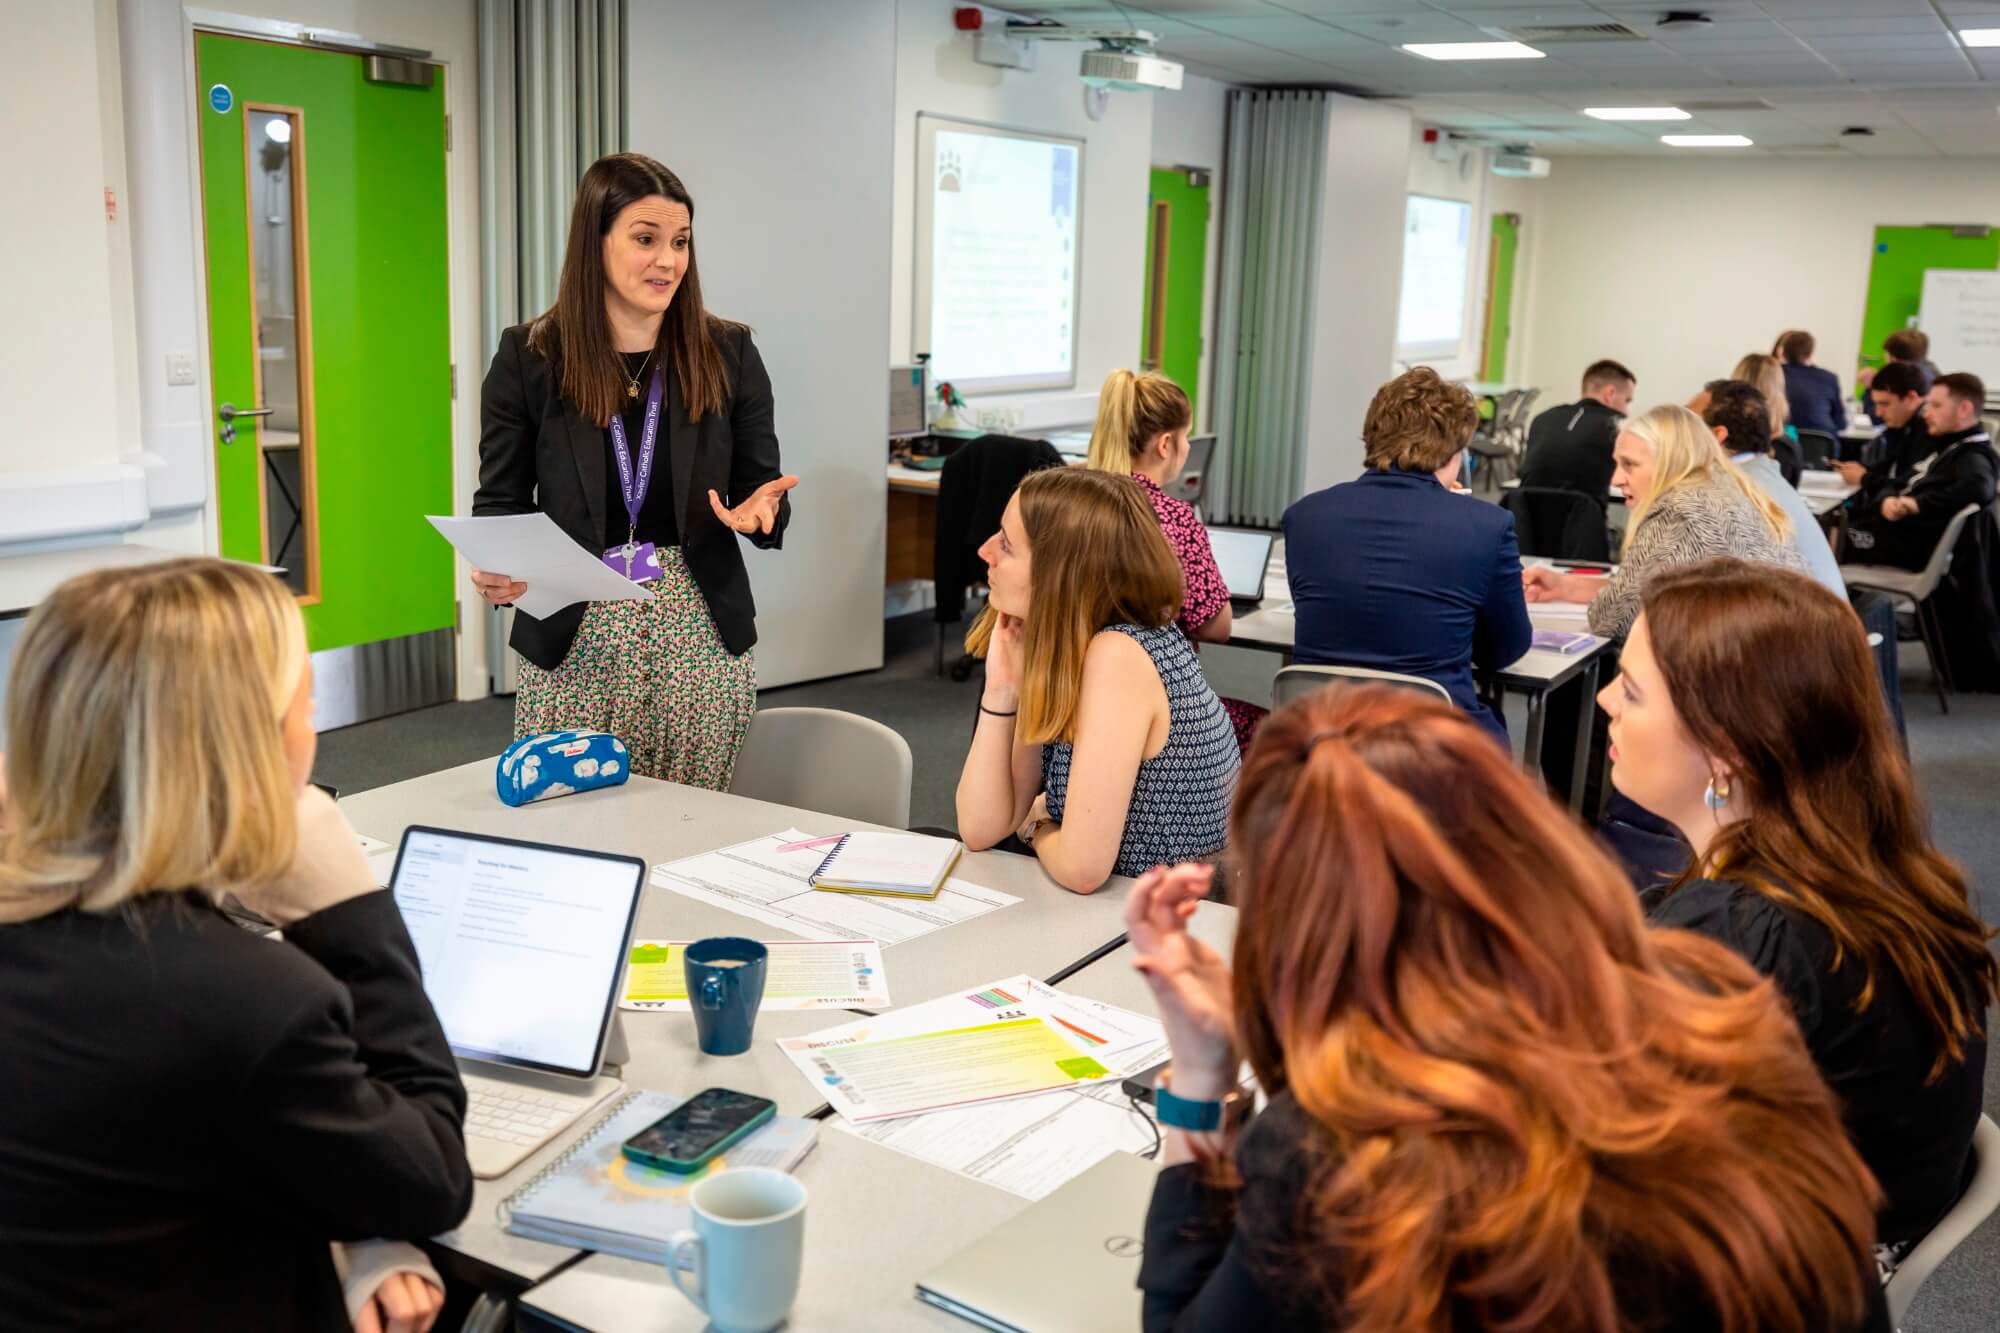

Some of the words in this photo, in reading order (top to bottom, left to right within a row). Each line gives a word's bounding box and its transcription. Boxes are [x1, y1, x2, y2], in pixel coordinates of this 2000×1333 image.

[648, 401, 658, 418] Trust
[643, 419, 655, 450] Education
[613, 424, 625, 451] Catholic
[619, 451, 630, 484] Education
[625, 484, 633, 502] Trust
[640, 450, 650, 477] Catholic
[636, 478, 646, 500] Xavier
